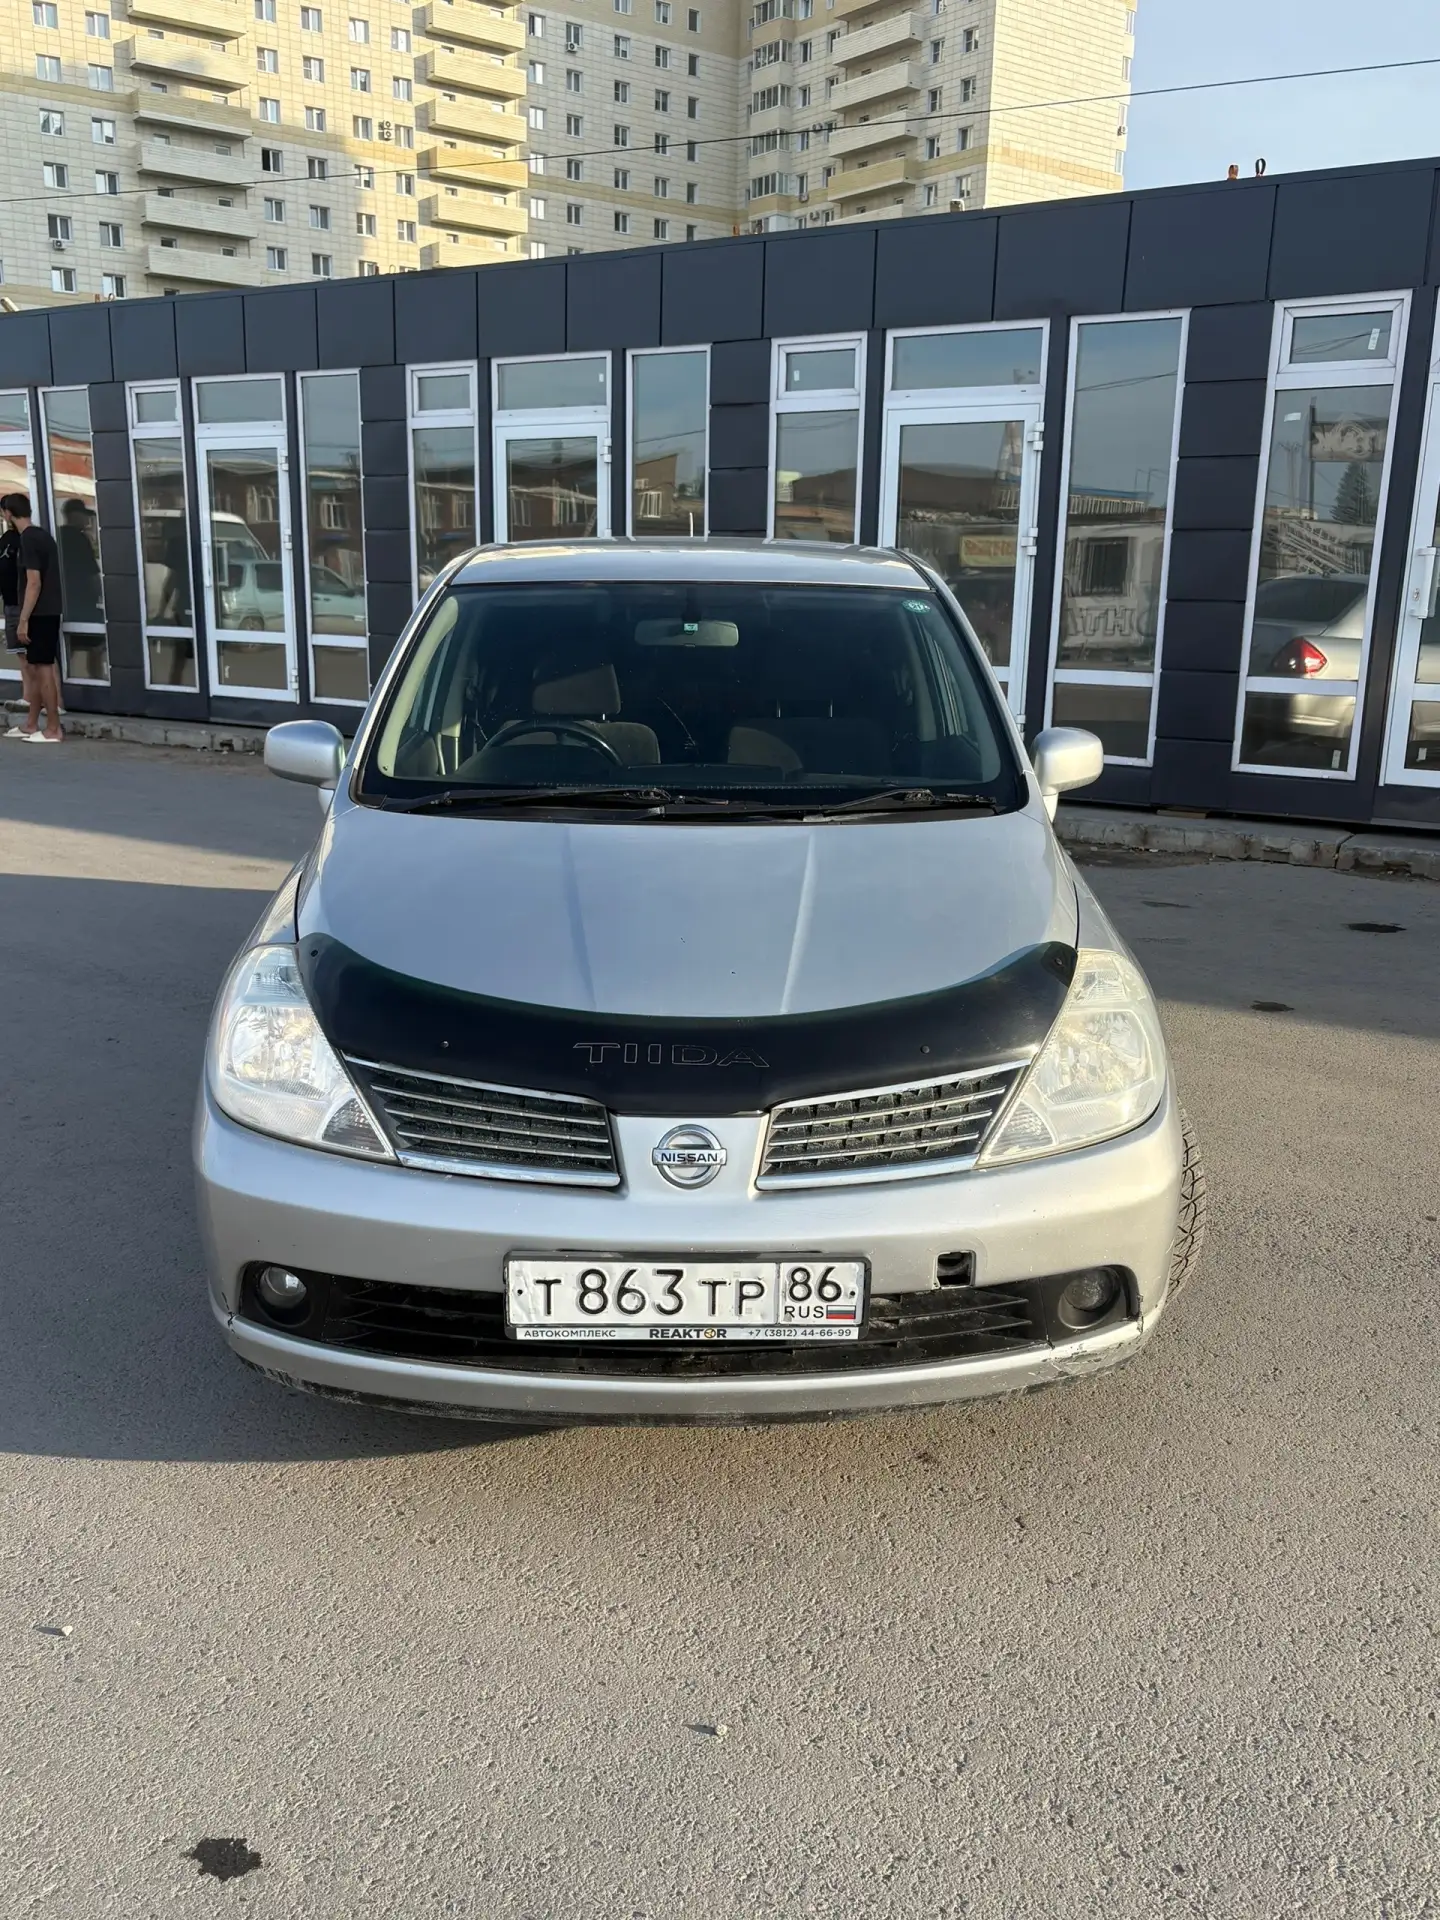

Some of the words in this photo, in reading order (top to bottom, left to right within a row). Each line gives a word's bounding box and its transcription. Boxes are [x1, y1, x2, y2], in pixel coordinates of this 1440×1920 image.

[573, 1042, 770, 1068] TIIDA
[661, 1152, 718, 1163] NISSAN
[789, 1266, 842, 1302] 86
[784, 1305, 824, 1319] RUS
[524, 1329, 616, 1338] АВТОКОМПЛЕКС
[649, 1328, 727, 1338] REAKTOR
[748, 1328, 761, 1337] +7
[764, 1328, 797, 1338] (3812)
[800, 1328, 852, 1337] 44-66-99
